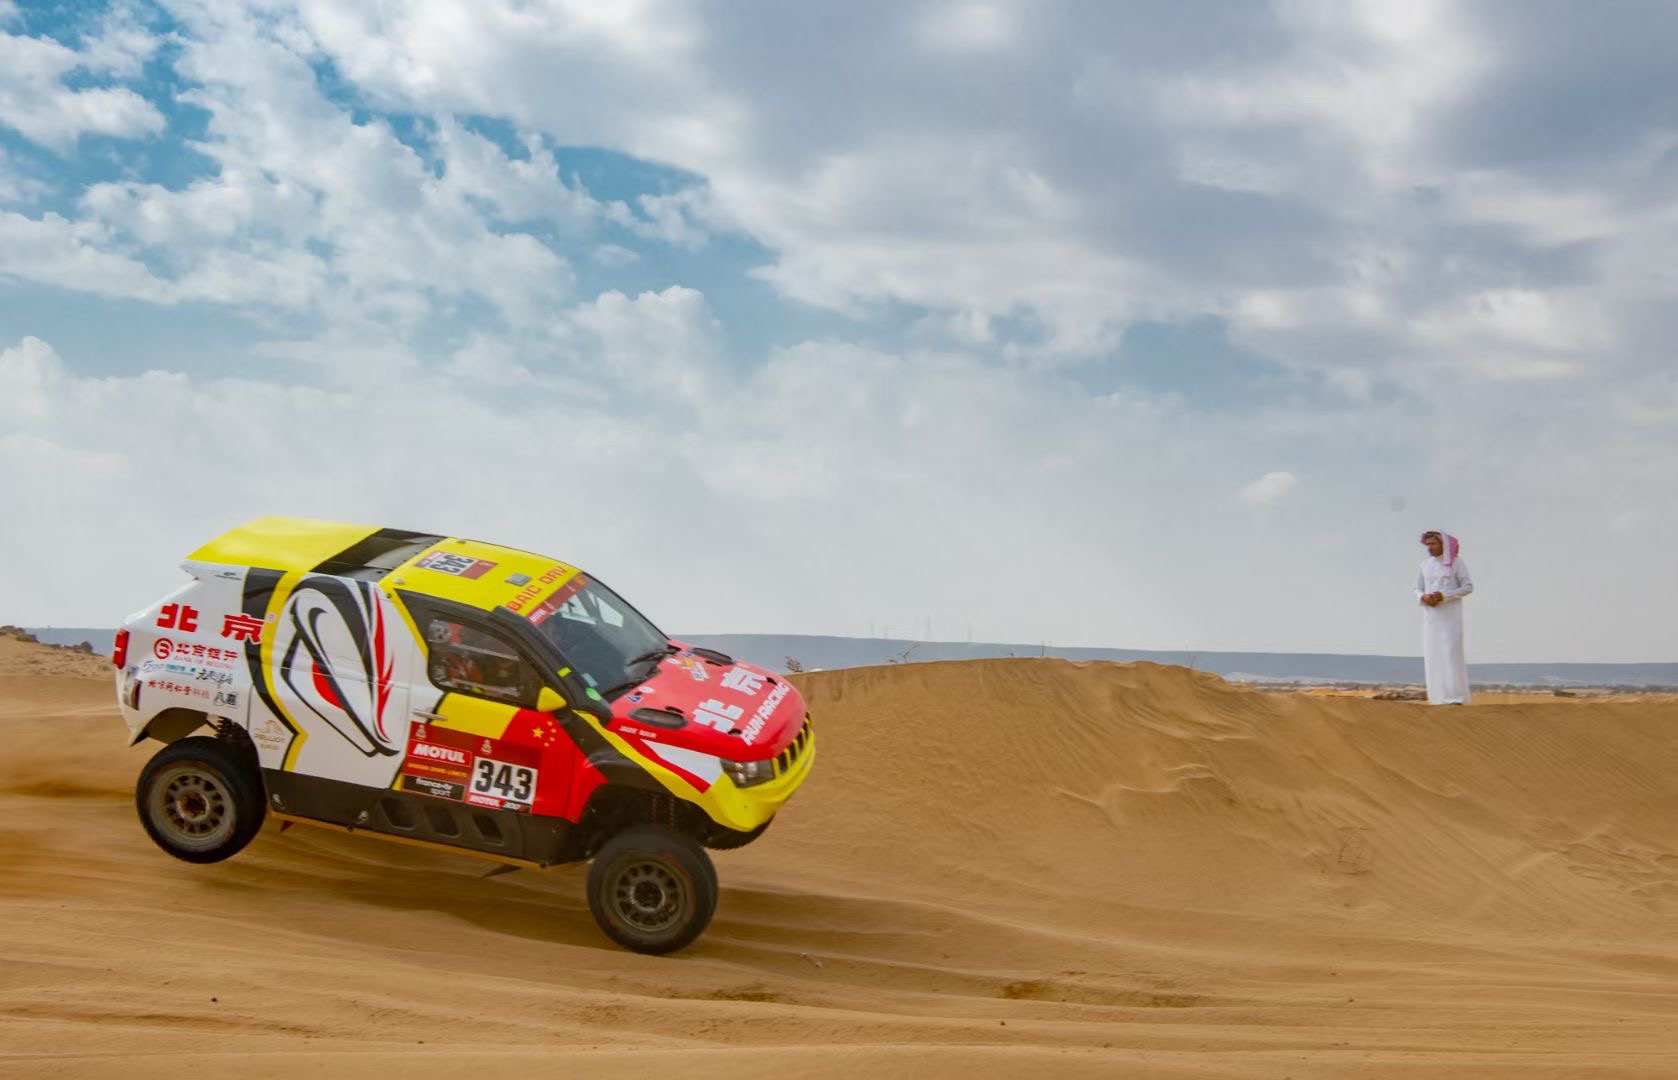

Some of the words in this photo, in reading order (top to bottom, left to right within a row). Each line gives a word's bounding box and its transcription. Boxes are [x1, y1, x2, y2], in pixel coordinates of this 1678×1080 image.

[429, 554, 474, 574] 343
[506, 585, 542, 611] BAIC
[156, 602, 265, 644] 北京
[691, 666, 768, 734] 北京
[413, 743, 465, 763] MOTUL
[475, 759, 533, 801] 343
[469, 795, 500, 807] MOTUL
